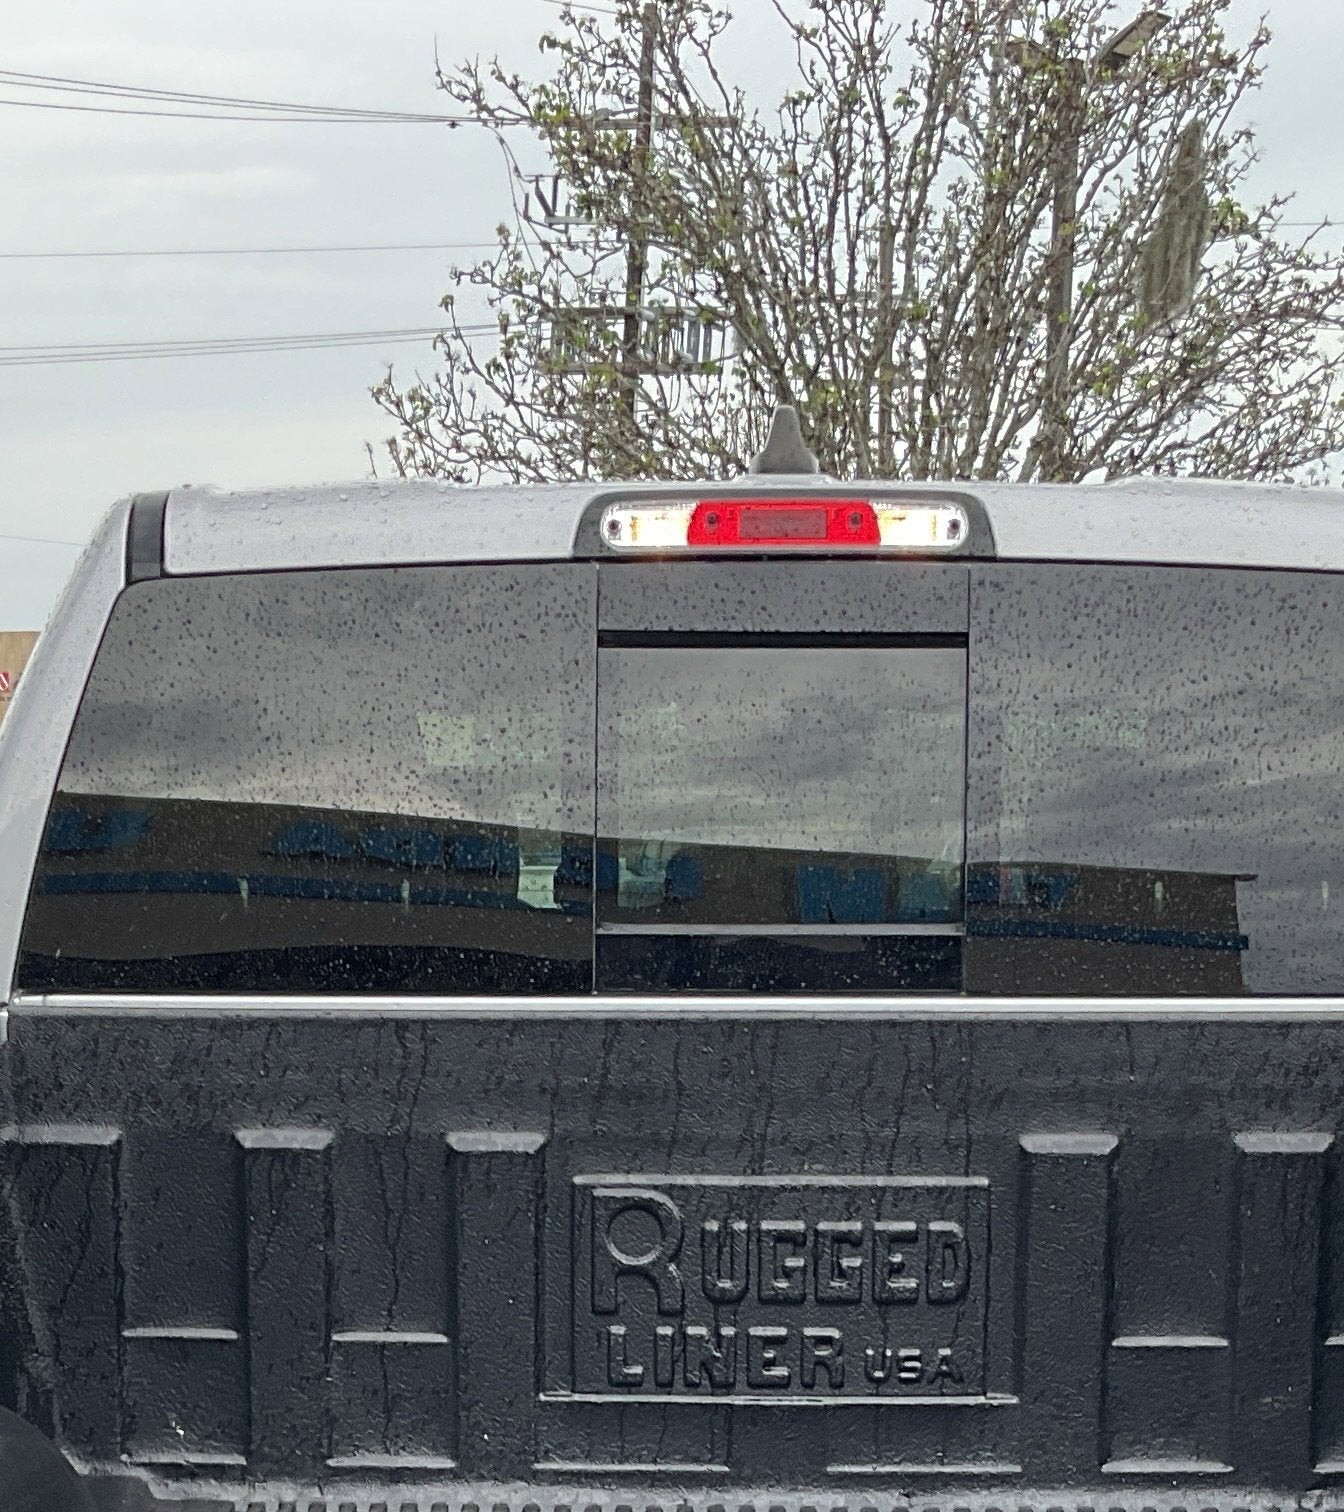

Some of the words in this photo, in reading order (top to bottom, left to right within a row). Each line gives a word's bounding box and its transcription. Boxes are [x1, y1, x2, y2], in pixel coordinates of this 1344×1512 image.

[590, 1187, 972, 1315] RUGGED
[606, 1326, 846, 1388] LINER
[863, 1347, 966, 1383] USA
